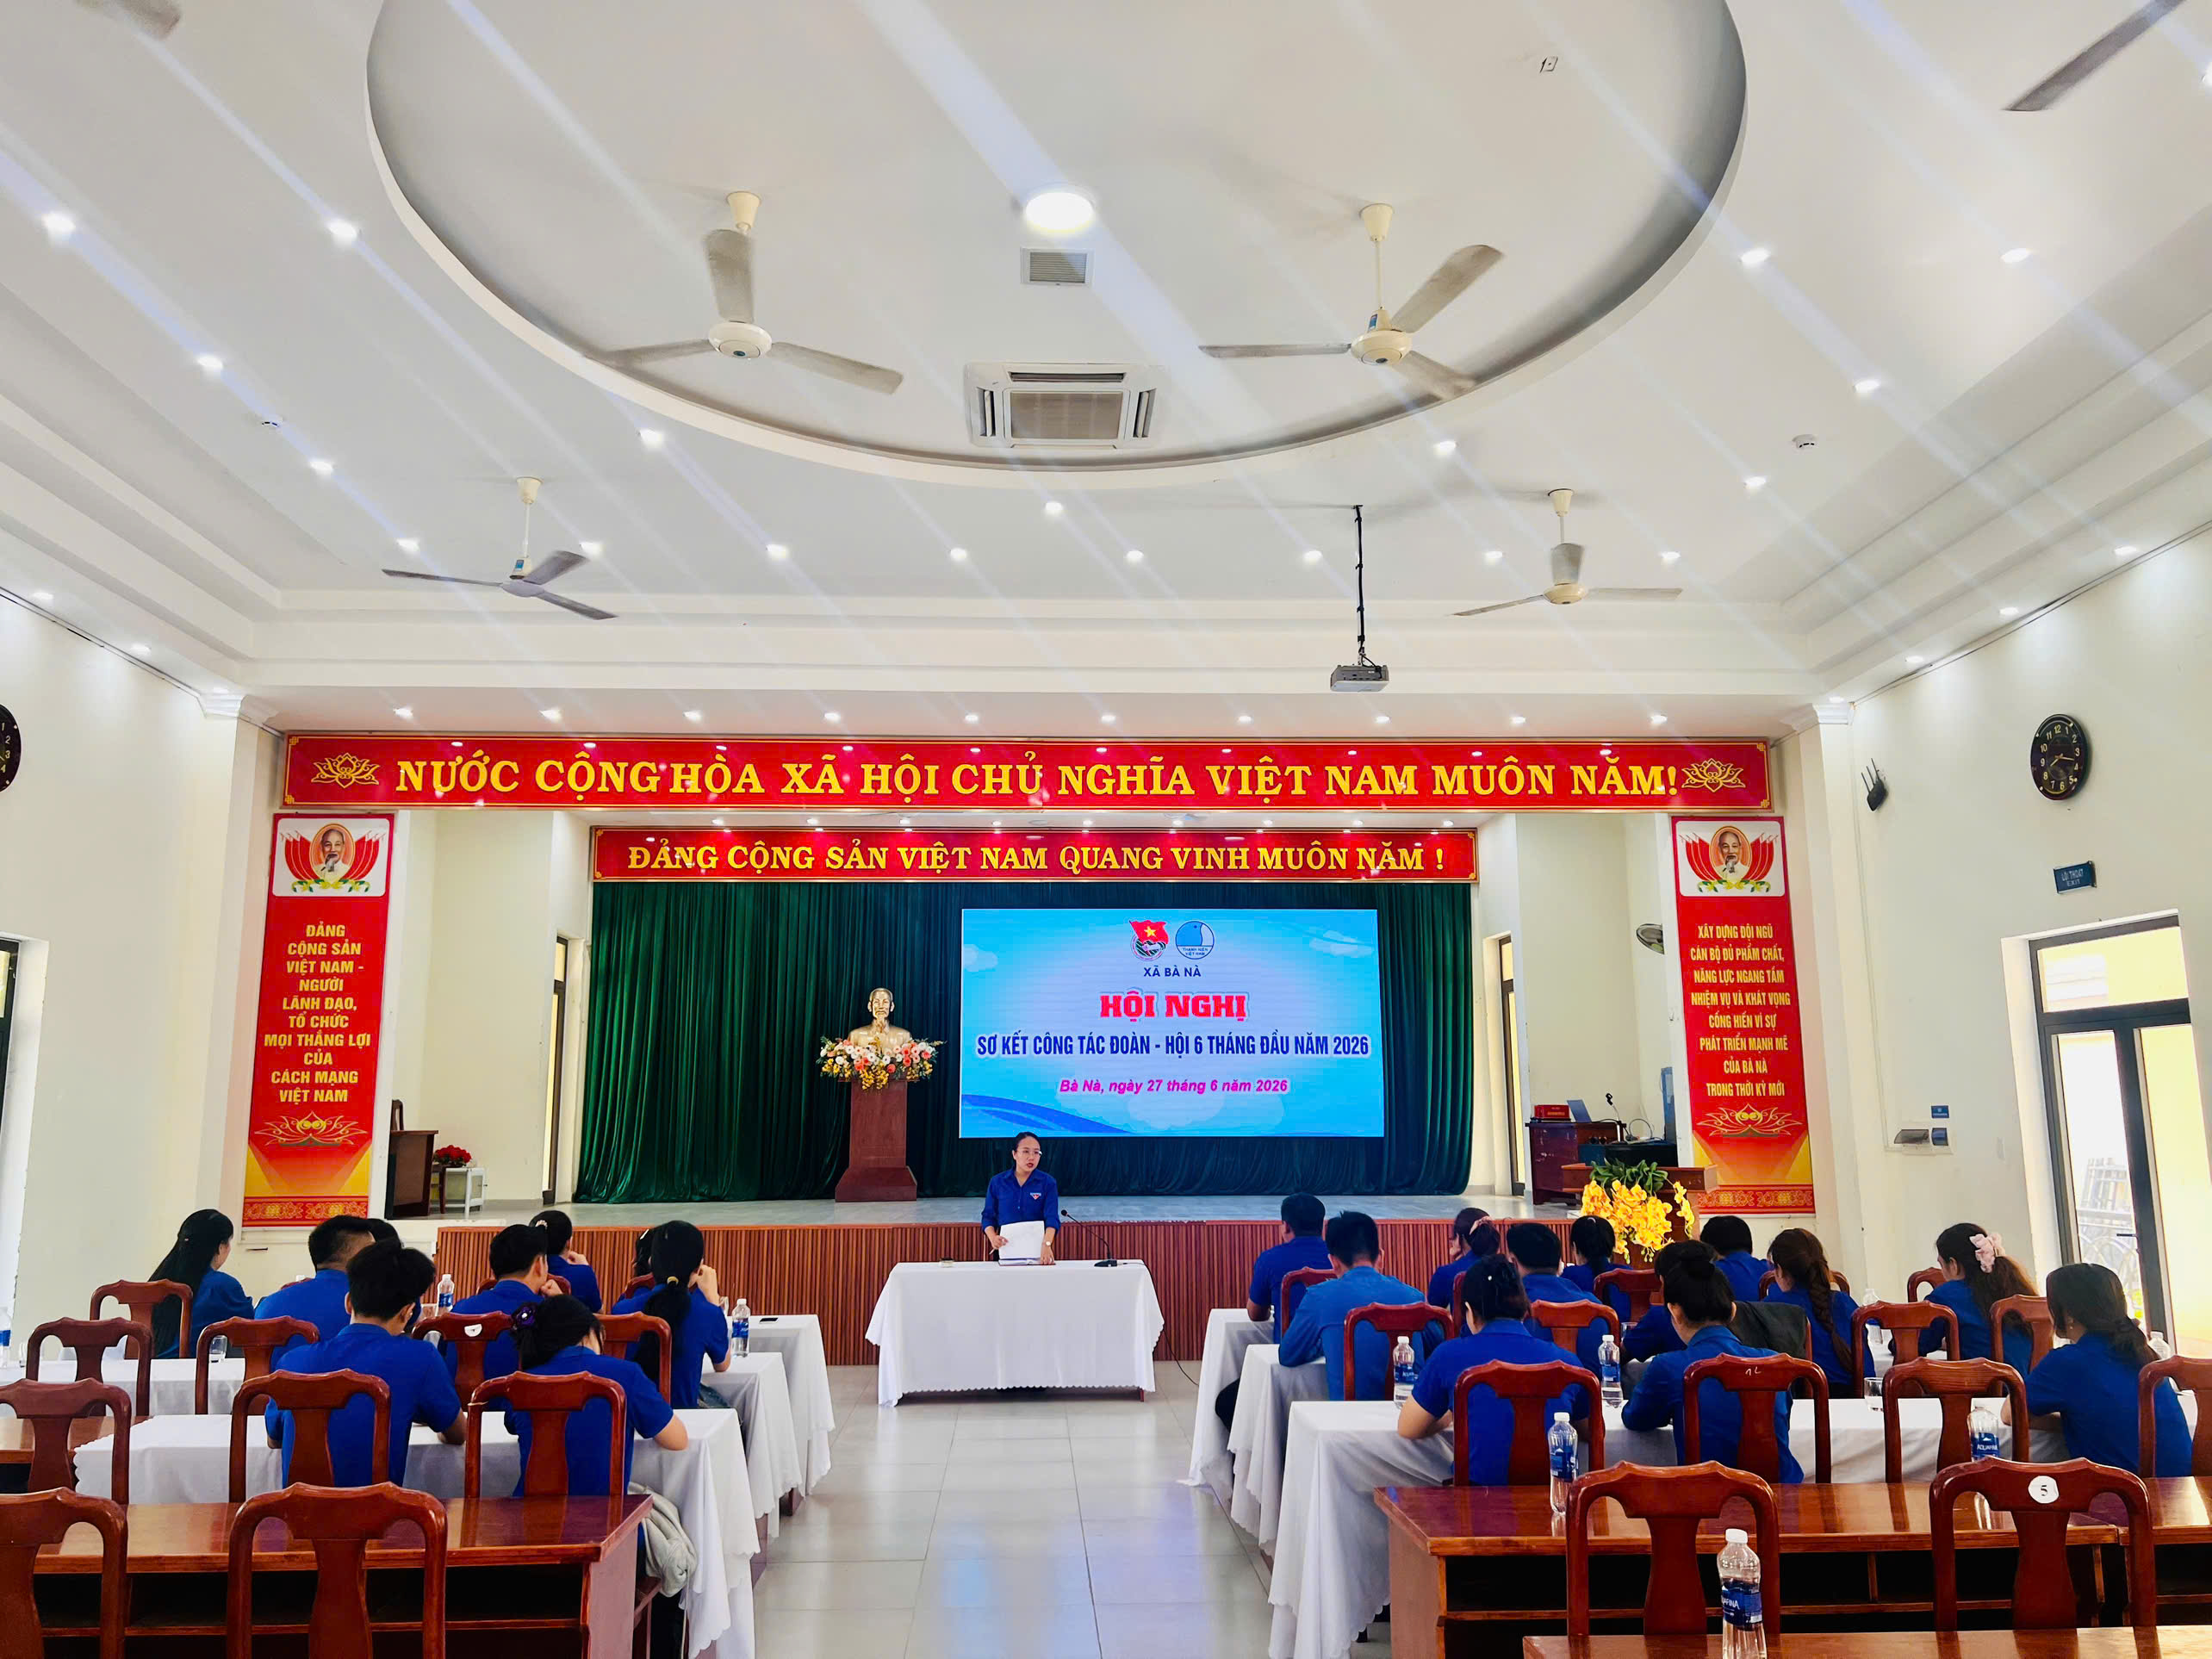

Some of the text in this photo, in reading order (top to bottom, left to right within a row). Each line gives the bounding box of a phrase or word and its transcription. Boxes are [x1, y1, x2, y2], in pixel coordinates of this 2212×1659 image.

[395, 749, 1677, 805] NƯỚC CỘNG HÒA XÃ HỘI CHỦ NGHĨA VIỆT NAM MUÔN NĂM!
[628, 838, 719, 869] ĐẢNG
[727, 841, 815, 874] CỘNG
[826, 838, 889, 870] SẢN
[897, 842, 972, 874] VIỆT
[980, 847, 1048, 870] NAM
[1059, 846, 1164, 875] QUANG
[1170, 847, 1250, 870] VINH
[1257, 841, 1349, 870] MUÔN
[1357, 841, 1424, 871] NĂM
[306, 921, 346, 937] ĐẢNG
[1698, 923, 1714, 939] XÂY
[288, 939, 362, 958] CỘNG SẢN
[1690, 945, 1707, 961] CÁN
[1709, 945, 1721, 964] BỘ
[287, 958, 316, 976] VIỆT
[320, 960, 354, 973] NAM
[1143, 965, 1201, 977] XÃ BÀ NÀ
[299, 976, 344, 991] NGƯỜI
[1718, 969, 1735, 985] LỰC
[1737, 970, 1765, 984] NGANG
[283, 995, 357, 1013] LÃNH ĐẠO,
[1100, 991, 1246, 1022] HỘI NGHỊ
[1691, 990, 1791, 1009] NHIỆM VỤ VÀ KHÁT VỌNG
[289, 1010, 349, 1028] TỔ CHỨC
[1733, 1010, 1753, 1028] HIẾN
[1765, 1014, 1777, 1031] SỰ
[264, 1029, 371, 1050] MỌI THẮNG LỢI
[977, 1035, 997, 1055] SƠ
[1002, 1029, 1028, 1055] KẾT
[1034, 1032, 1073, 1055] CÔNG
[1078, 1032, 1105, 1055] TÁC
[1109, 1031, 1150, 1055] ĐOÀN
[1165, 1032, 1190, 1059] HỘI
[1194, 1035, 1202, 1055] 6
[1208, 1032, 1256, 1055] THÁNG
[1260, 1029, 1289, 1055] ĐẦU
[1295, 1032, 1328, 1055] NĂM
[1333, 1035, 1369, 1055] 2026
[1699, 1035, 1721, 1051] PHÁT
[1748, 1037, 1774, 1054] MẠNH
[1775, 1035, 1789, 1051] MẼ
[304, 1048, 333, 1066] CỦA
[1724, 1055, 1768, 1073] CỦA BÀ NÀ
[271, 1068, 358, 1087] CÁCH MẠNG
[279, 1087, 348, 1105] VIỆT NAM
[1059, 1079, 1288, 1095] Bà Nà, ngày 27 tháng 6 năm 2026
[1706, 1083, 1734, 1097] TRONG
[1768, 1080, 1785, 1097] MỚI
[2041, 1485, 2047, 1496] 5
